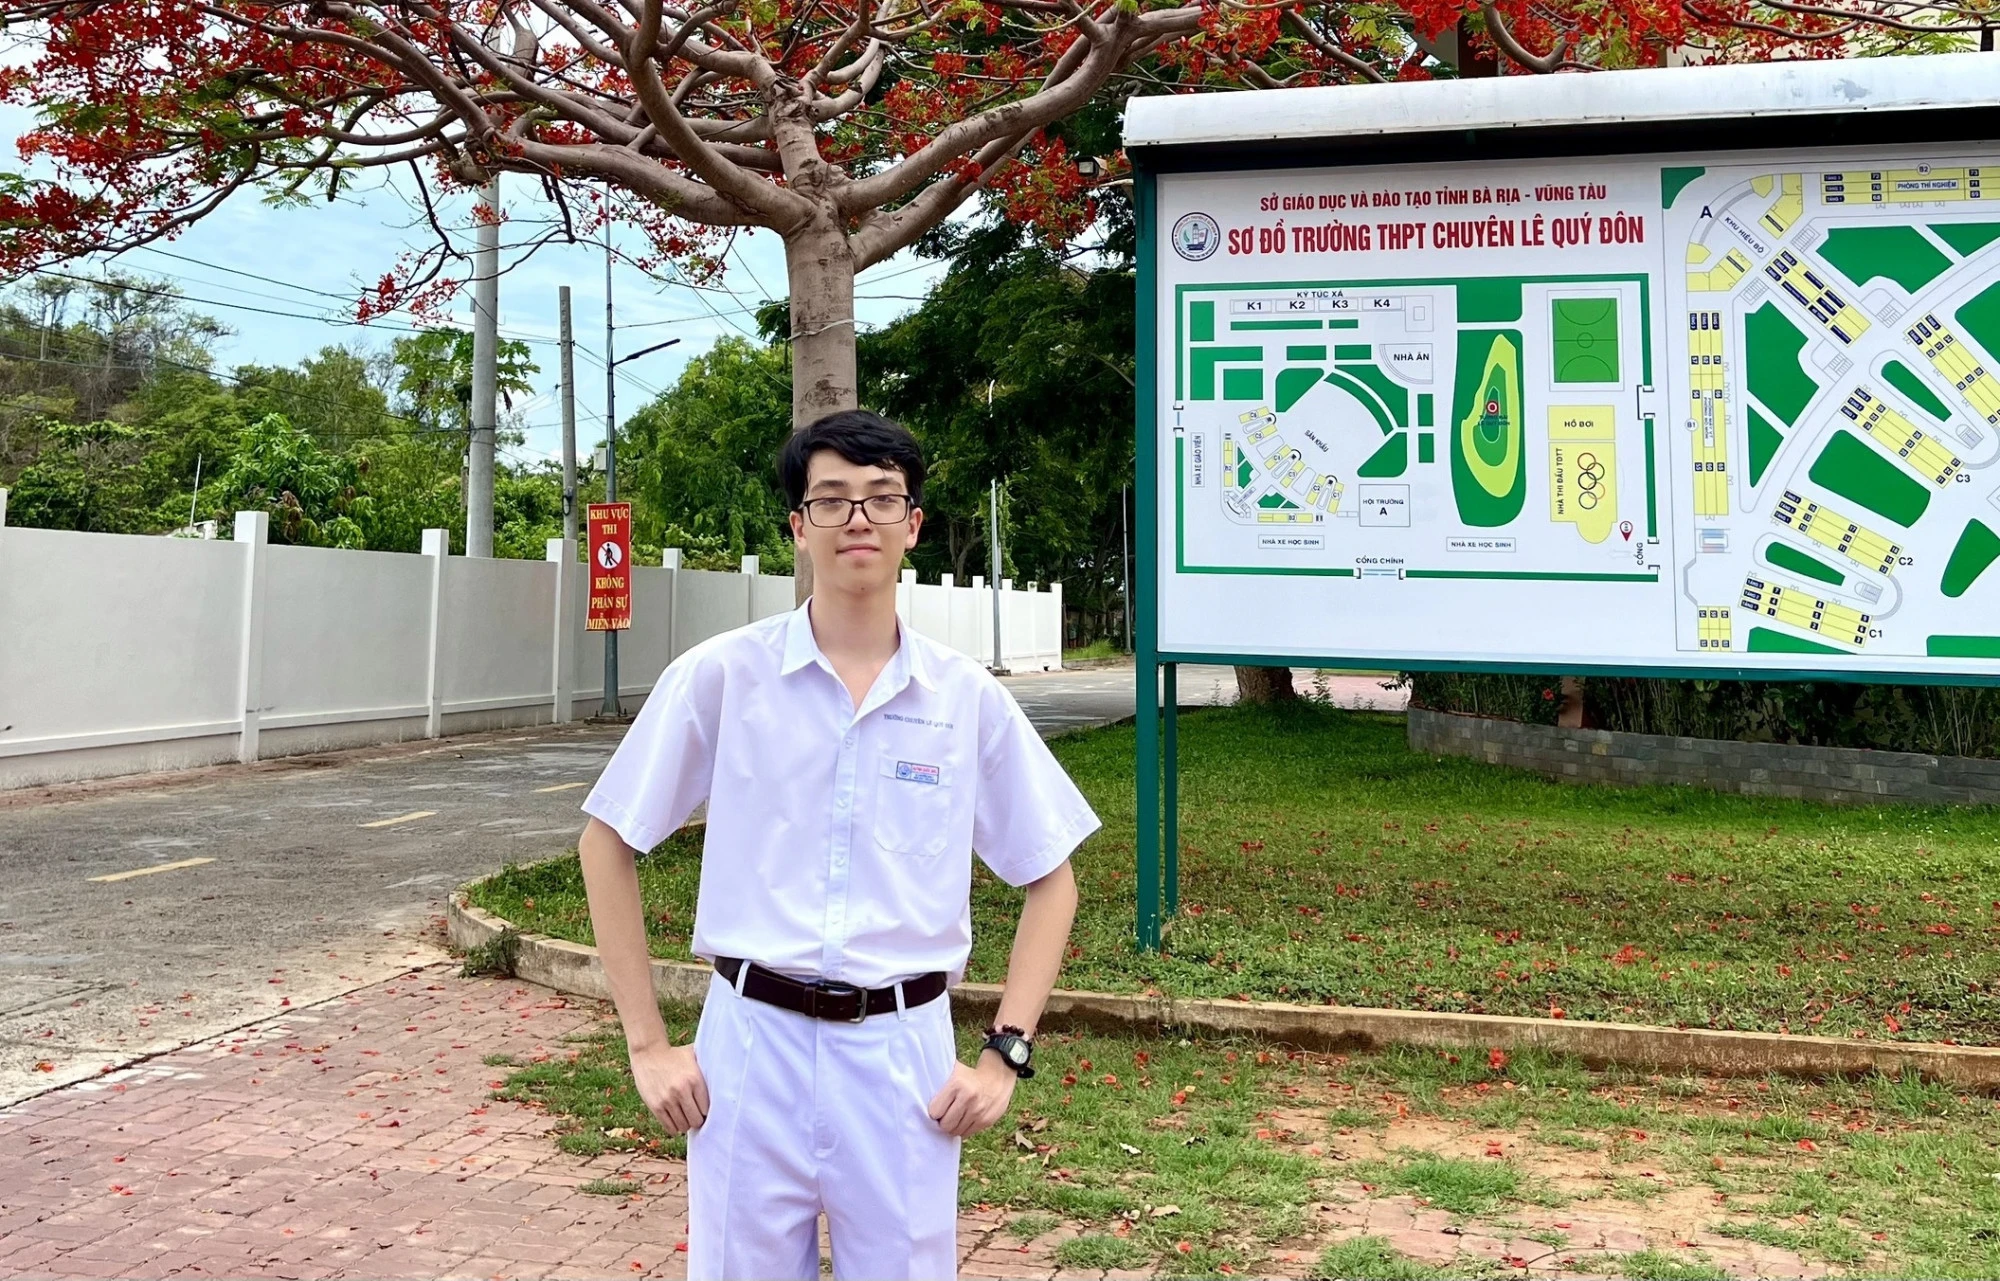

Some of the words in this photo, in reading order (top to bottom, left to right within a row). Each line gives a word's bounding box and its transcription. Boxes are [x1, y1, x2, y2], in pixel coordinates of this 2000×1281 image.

[1932, 180, 1956, 188] NGHIỆM
[1261, 192, 1278, 211] SỞ
[1283, 194, 1314, 210] GIÁO
[1320, 194, 1346, 212] DỤC
[1351, 190, 1368, 208] VÀ
[1373, 190, 1400, 206] ĐÀO
[1405, 191, 1431, 208] TẠO
[1436, 186, 1468, 205] TỈNH
[1473, 186, 1492, 204] BÀ
[1496, 188, 1520, 206] RỊA
[1535, 184, 1574, 202] VŨNG
[1578, 182, 1606, 200] TÀU
[1700, 206, 1712, 218] A
[1724, 217, 1740, 232] KHU
[1228, 226, 1254, 255] SƠ
[1259, 218, 1285, 254] ĐỒ
[1292, 220, 1370, 252] TRƯỜNG
[1377, 222, 1426, 250] THPT
[1433, 215, 1514, 248] CHUYÊN
[1522, 214, 1544, 246] LÊ
[1552, 212, 1592, 248] QUÝ
[1599, 211, 1644, 244] ĐÔN
[1247, 302, 1262, 310] K1
[1289, 300, 1306, 309] K2
[1332, 300, 1348, 308] K3
[1374, 299, 1390, 308] K4
[1394, 352, 1413, 361] NHÀ
[1564, 419, 1577, 427] HỒ
[1956, 475, 1970, 483] C3
[590, 509, 609, 519] KHU
[611, 507, 629, 520] VỰC
[602, 524, 617, 534] THI
[1634, 542, 1643, 565] CỔNG
[1356, 555, 1378, 564] CỔNG
[1898, 557, 1913, 565] C2
[595, 575, 624, 589] KHÔNG
[1869, 630, 1883, 638] C1
